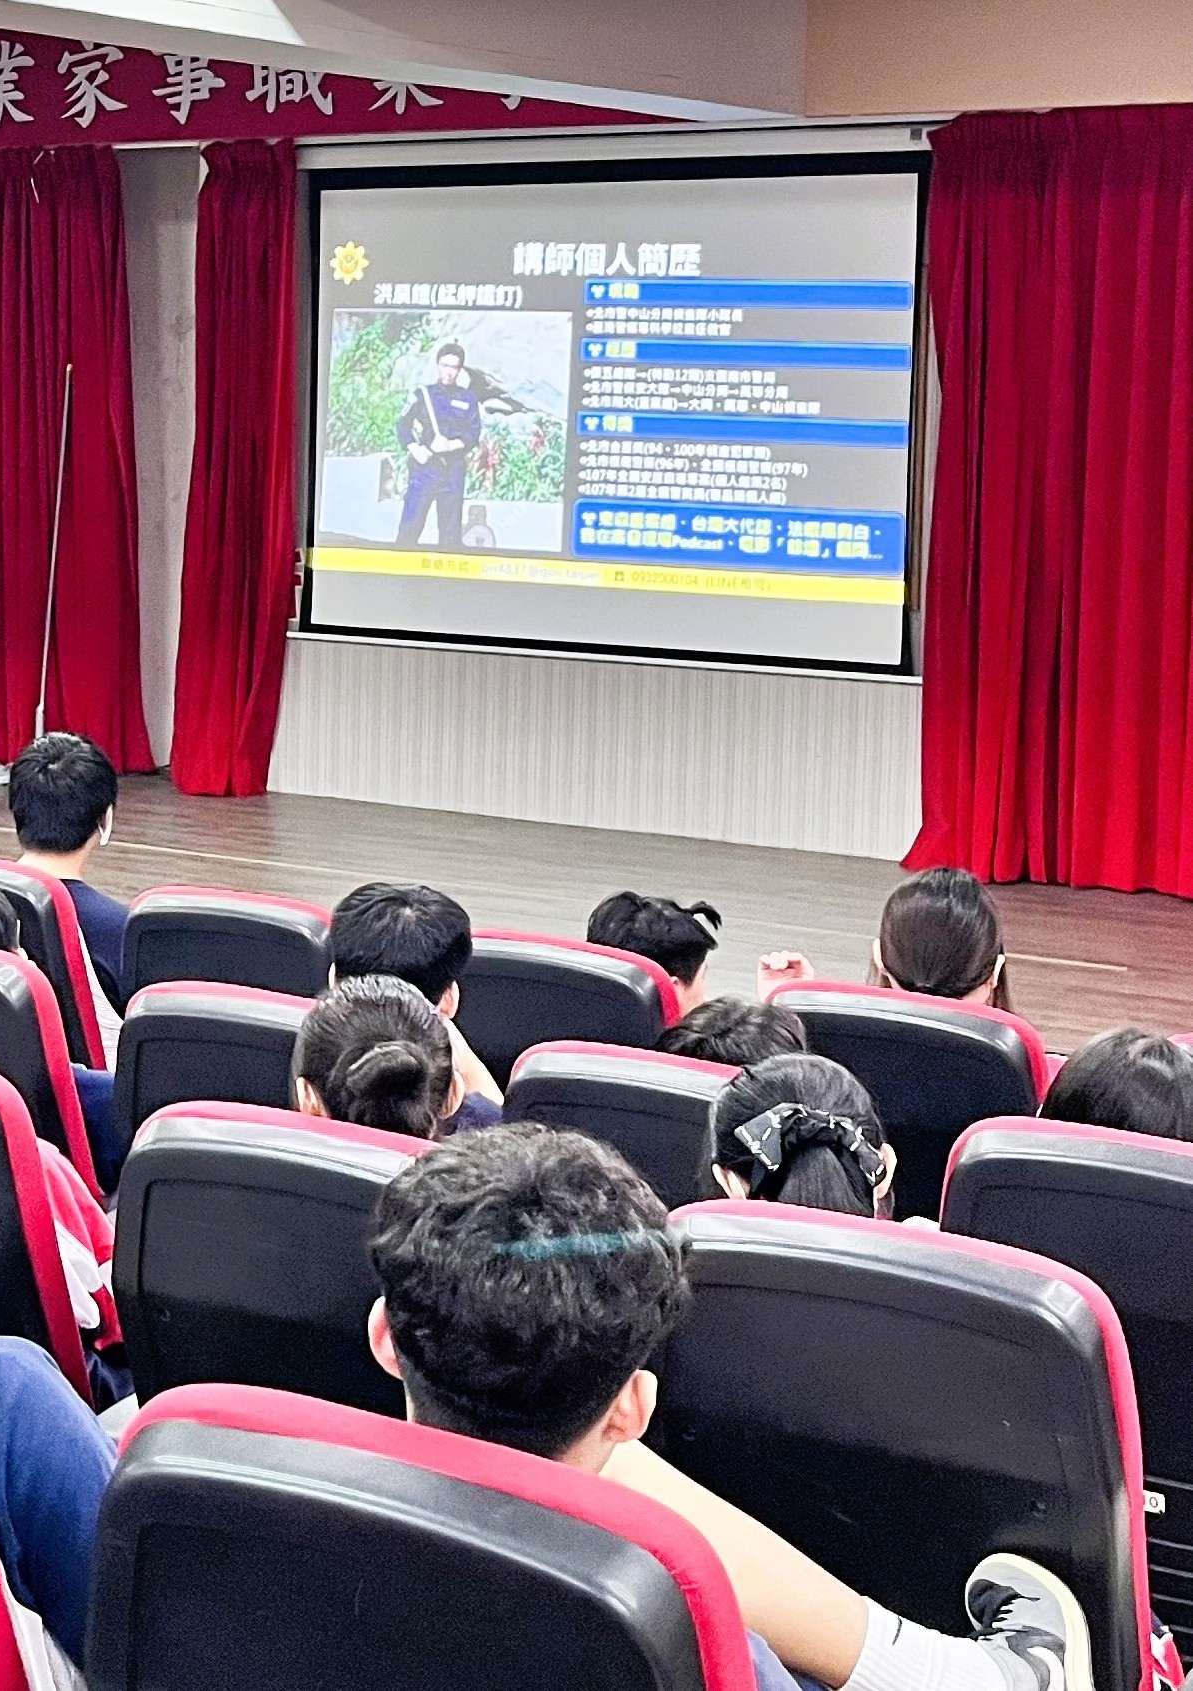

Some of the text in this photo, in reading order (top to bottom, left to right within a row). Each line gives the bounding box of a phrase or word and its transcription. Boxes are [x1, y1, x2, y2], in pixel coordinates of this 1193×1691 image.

[512, 242, 702, 277] 講師個人簡歷
